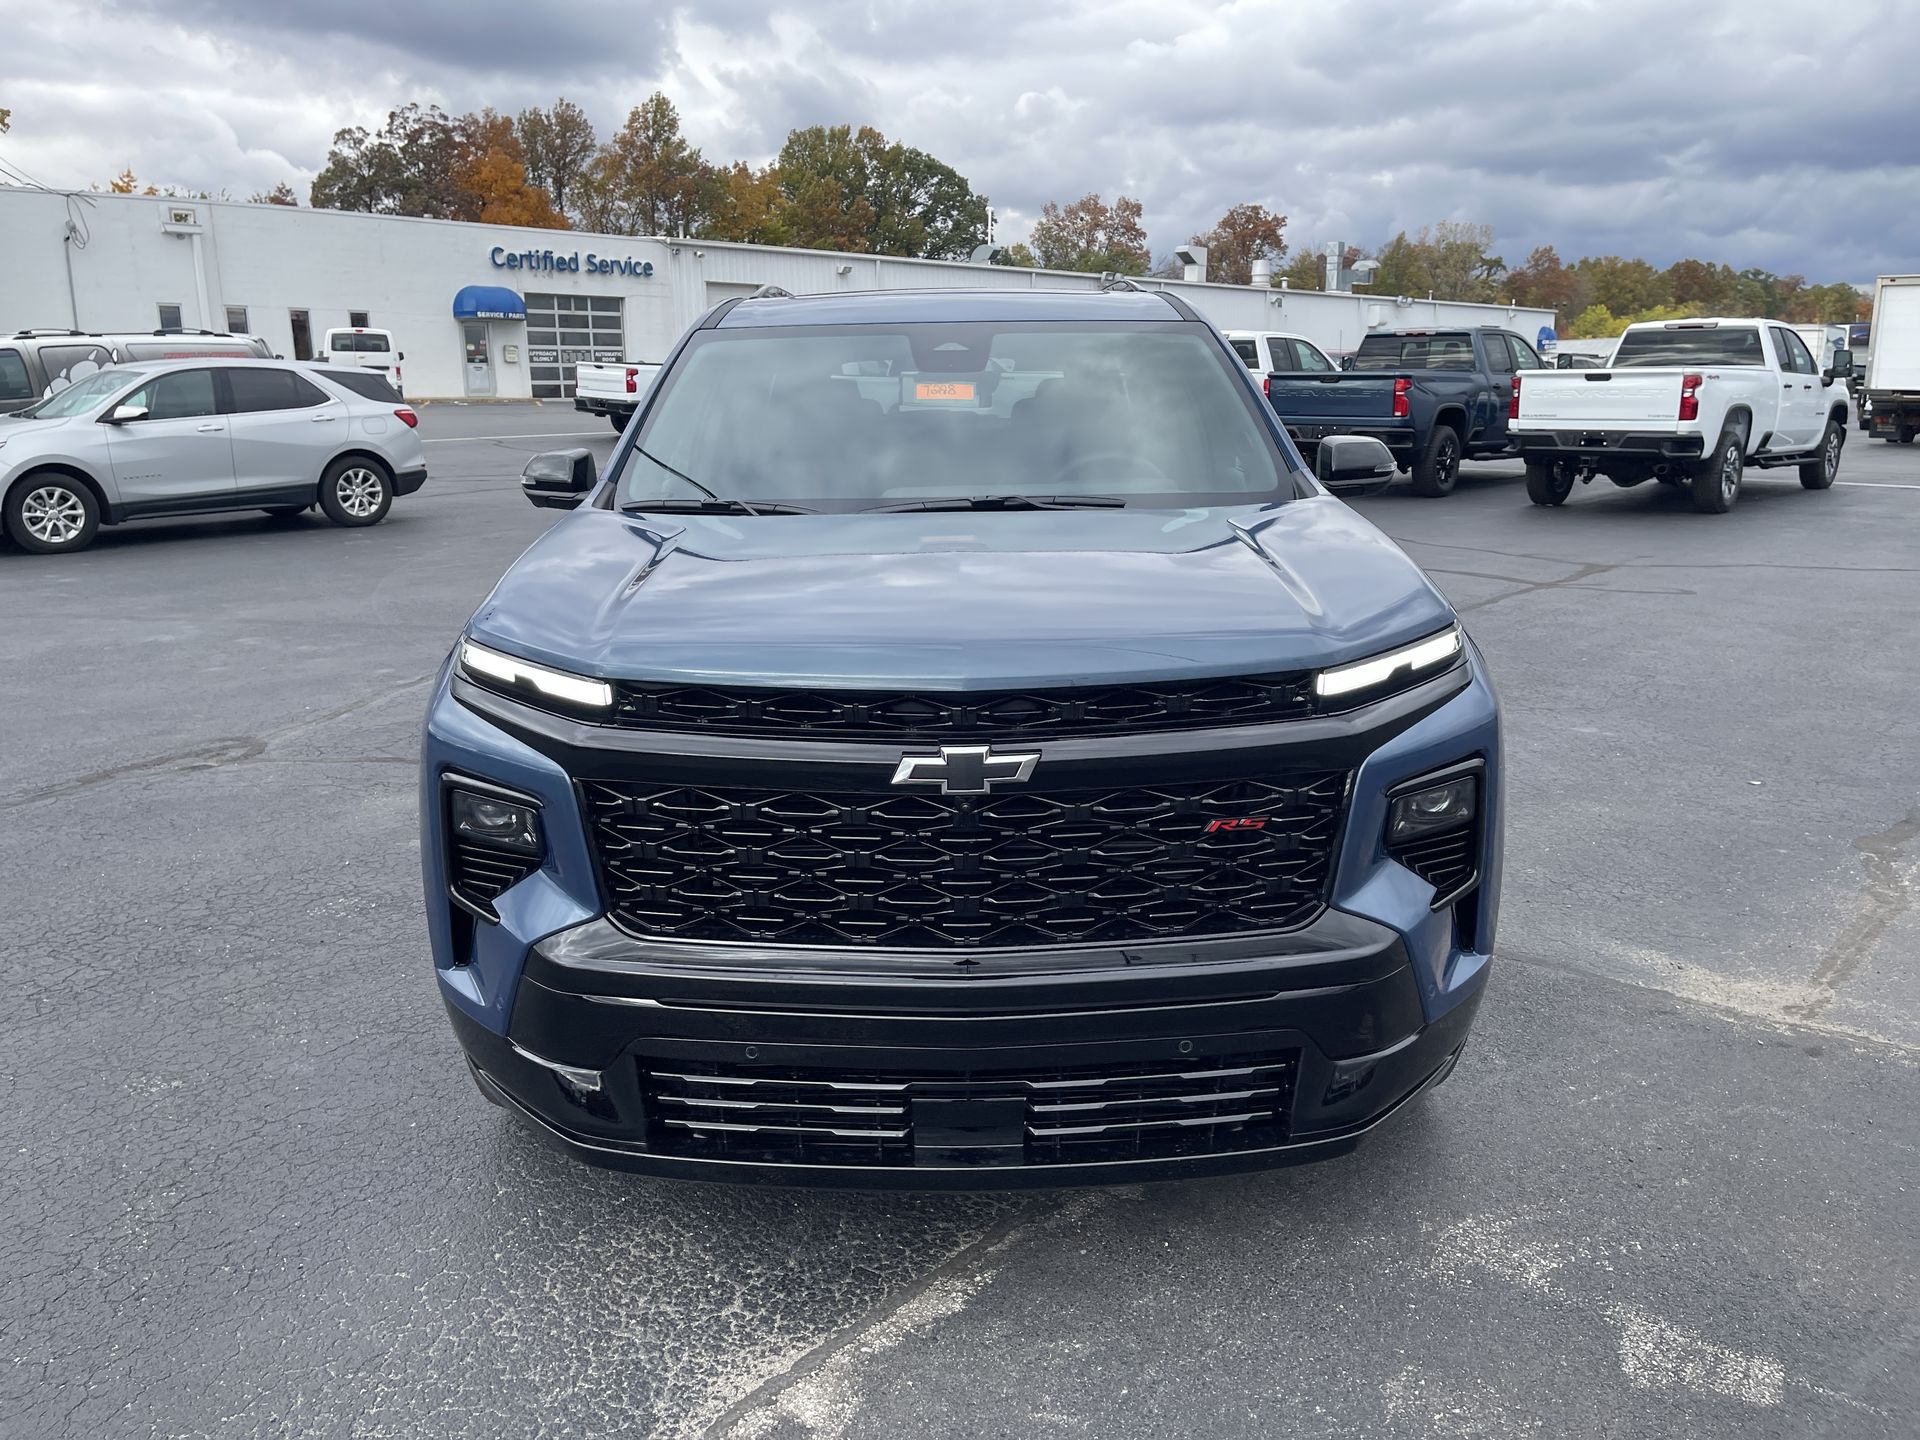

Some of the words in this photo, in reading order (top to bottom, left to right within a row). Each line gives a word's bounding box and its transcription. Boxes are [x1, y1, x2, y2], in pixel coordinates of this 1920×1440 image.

[490, 246, 579, 273] Certified
[586, 253, 654, 277] Service
[1276, 389, 1385, 398] CHEVROLET
[1528, 387, 1670, 399] CHEVROLET
[1203, 817, 1270, 833] RS
